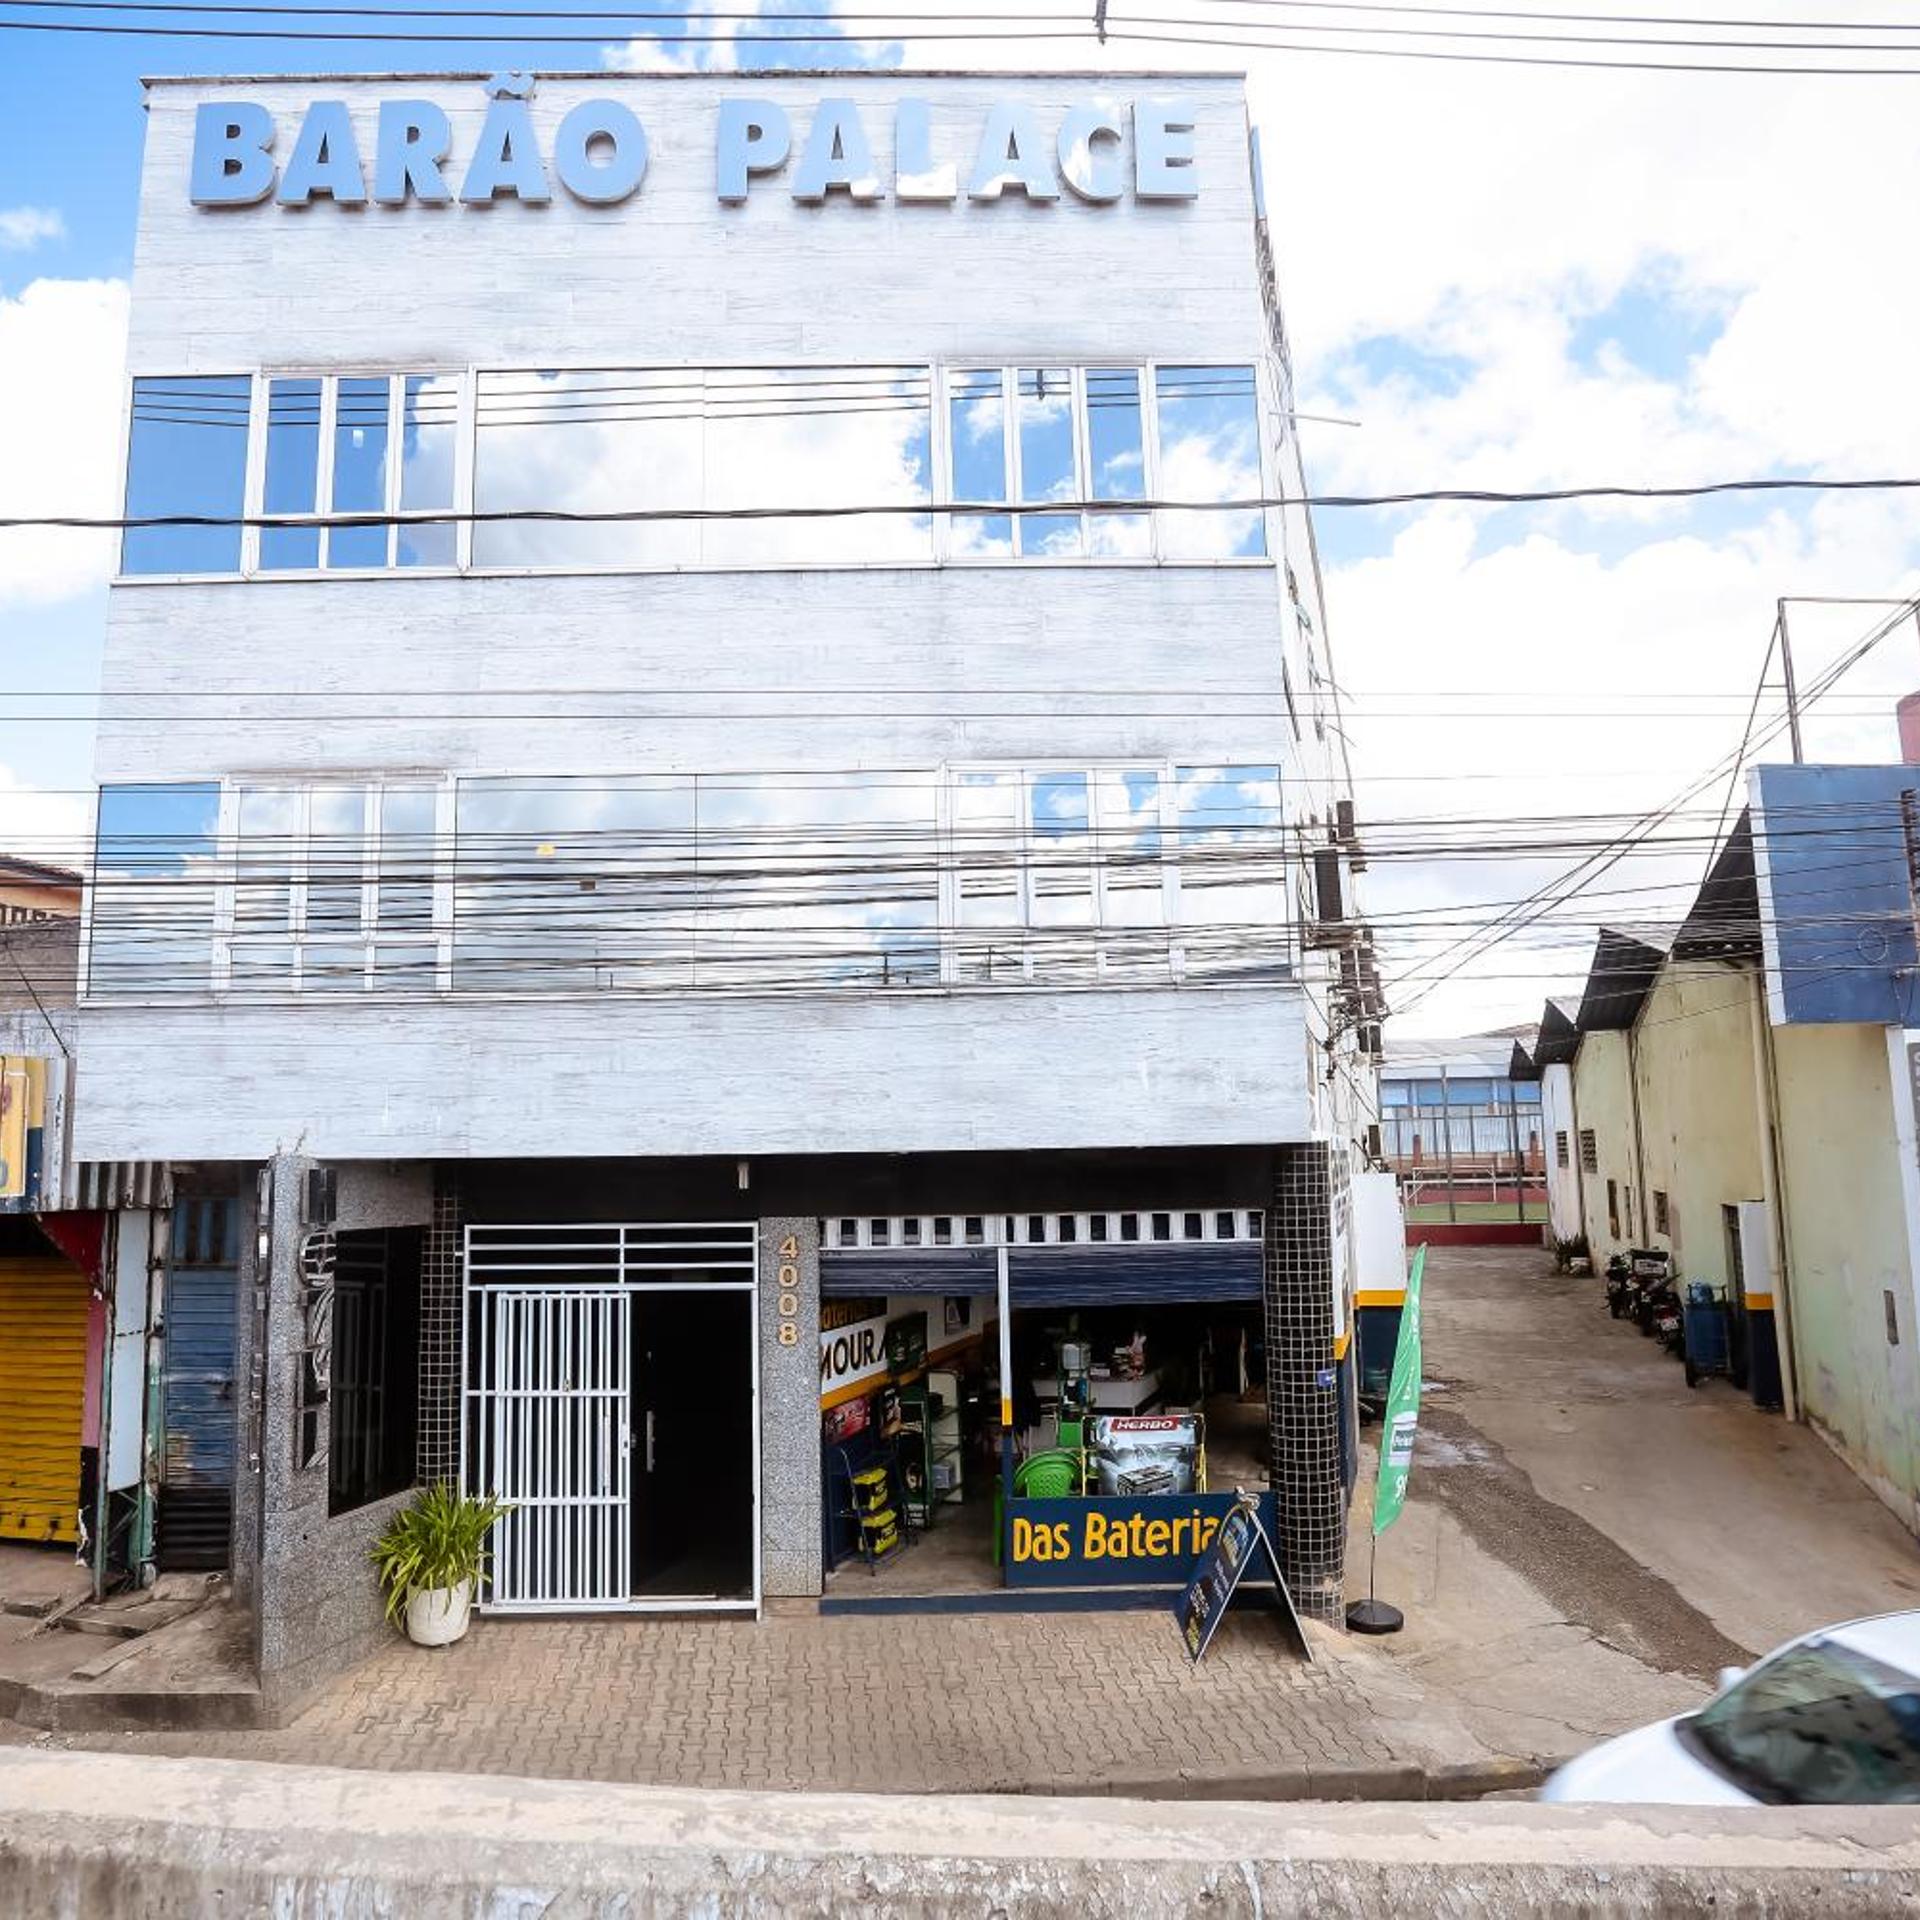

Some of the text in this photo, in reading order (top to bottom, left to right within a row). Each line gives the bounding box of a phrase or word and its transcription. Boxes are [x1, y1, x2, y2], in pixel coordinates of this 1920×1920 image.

[189, 72, 1199, 206] BARÃO PALACE
[778, 1233, 798, 1346] 4008
[1012, 1508, 1220, 1563] Das Bateria
